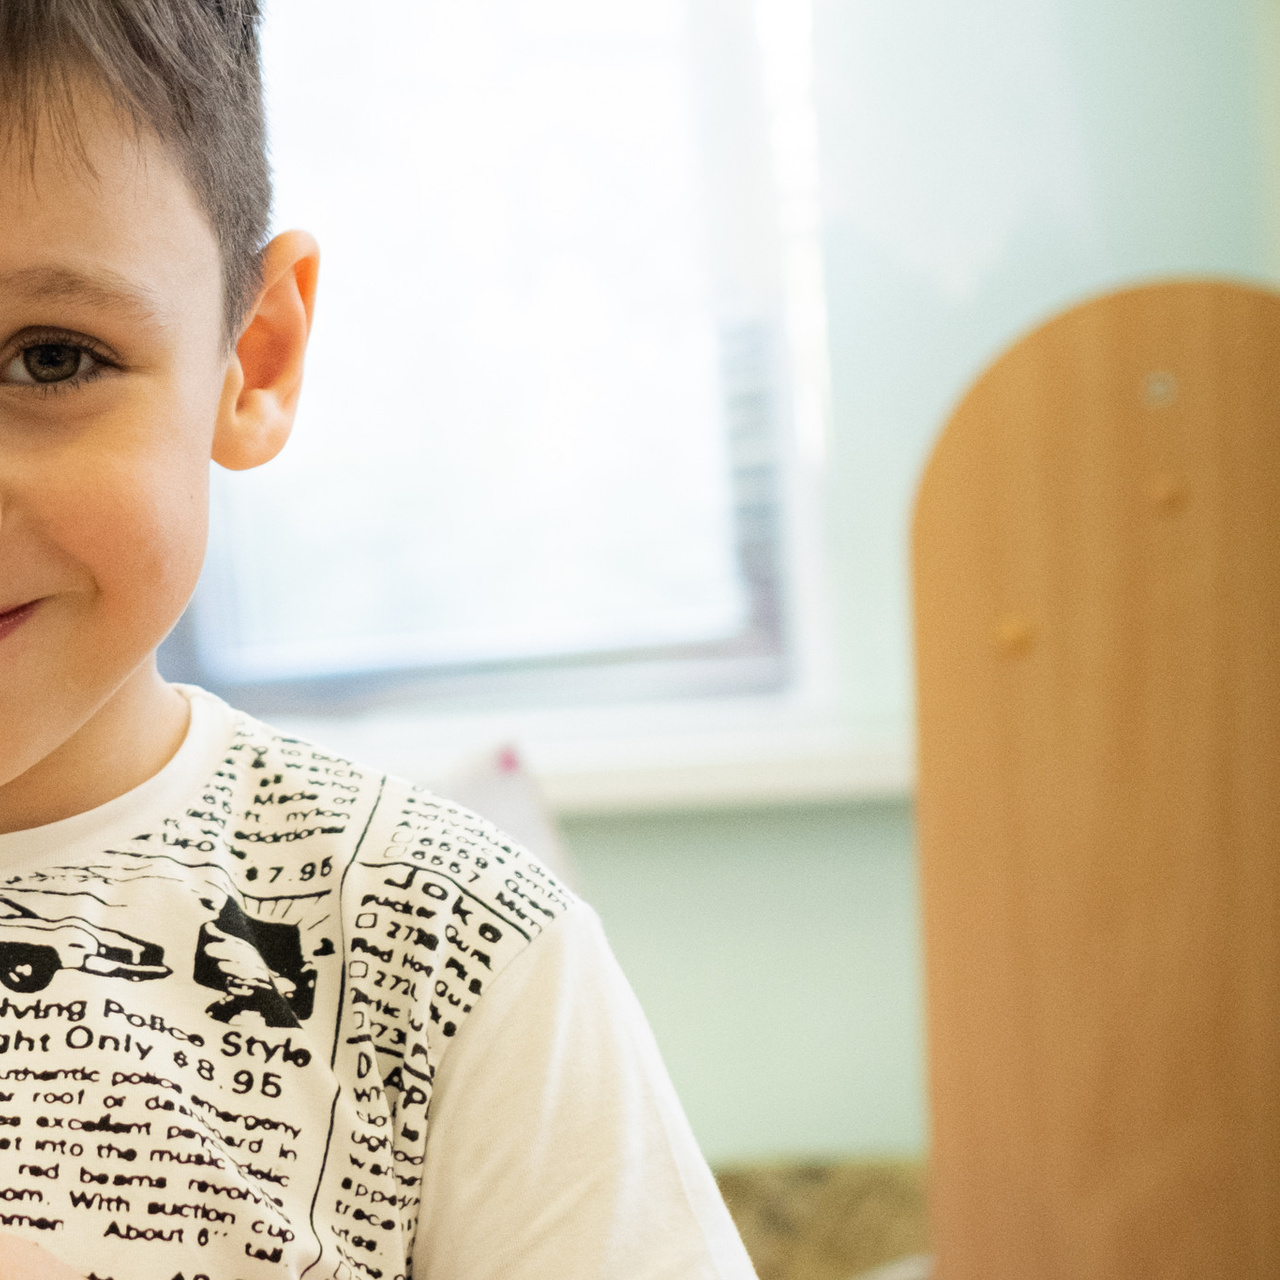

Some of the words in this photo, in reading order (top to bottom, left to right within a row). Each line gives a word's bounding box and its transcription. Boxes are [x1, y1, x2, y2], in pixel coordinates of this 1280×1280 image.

[65, 1025, 154, 1061] Only
[103, 998, 205, 1047] Police
[220, 1030, 312, 1068] Style
